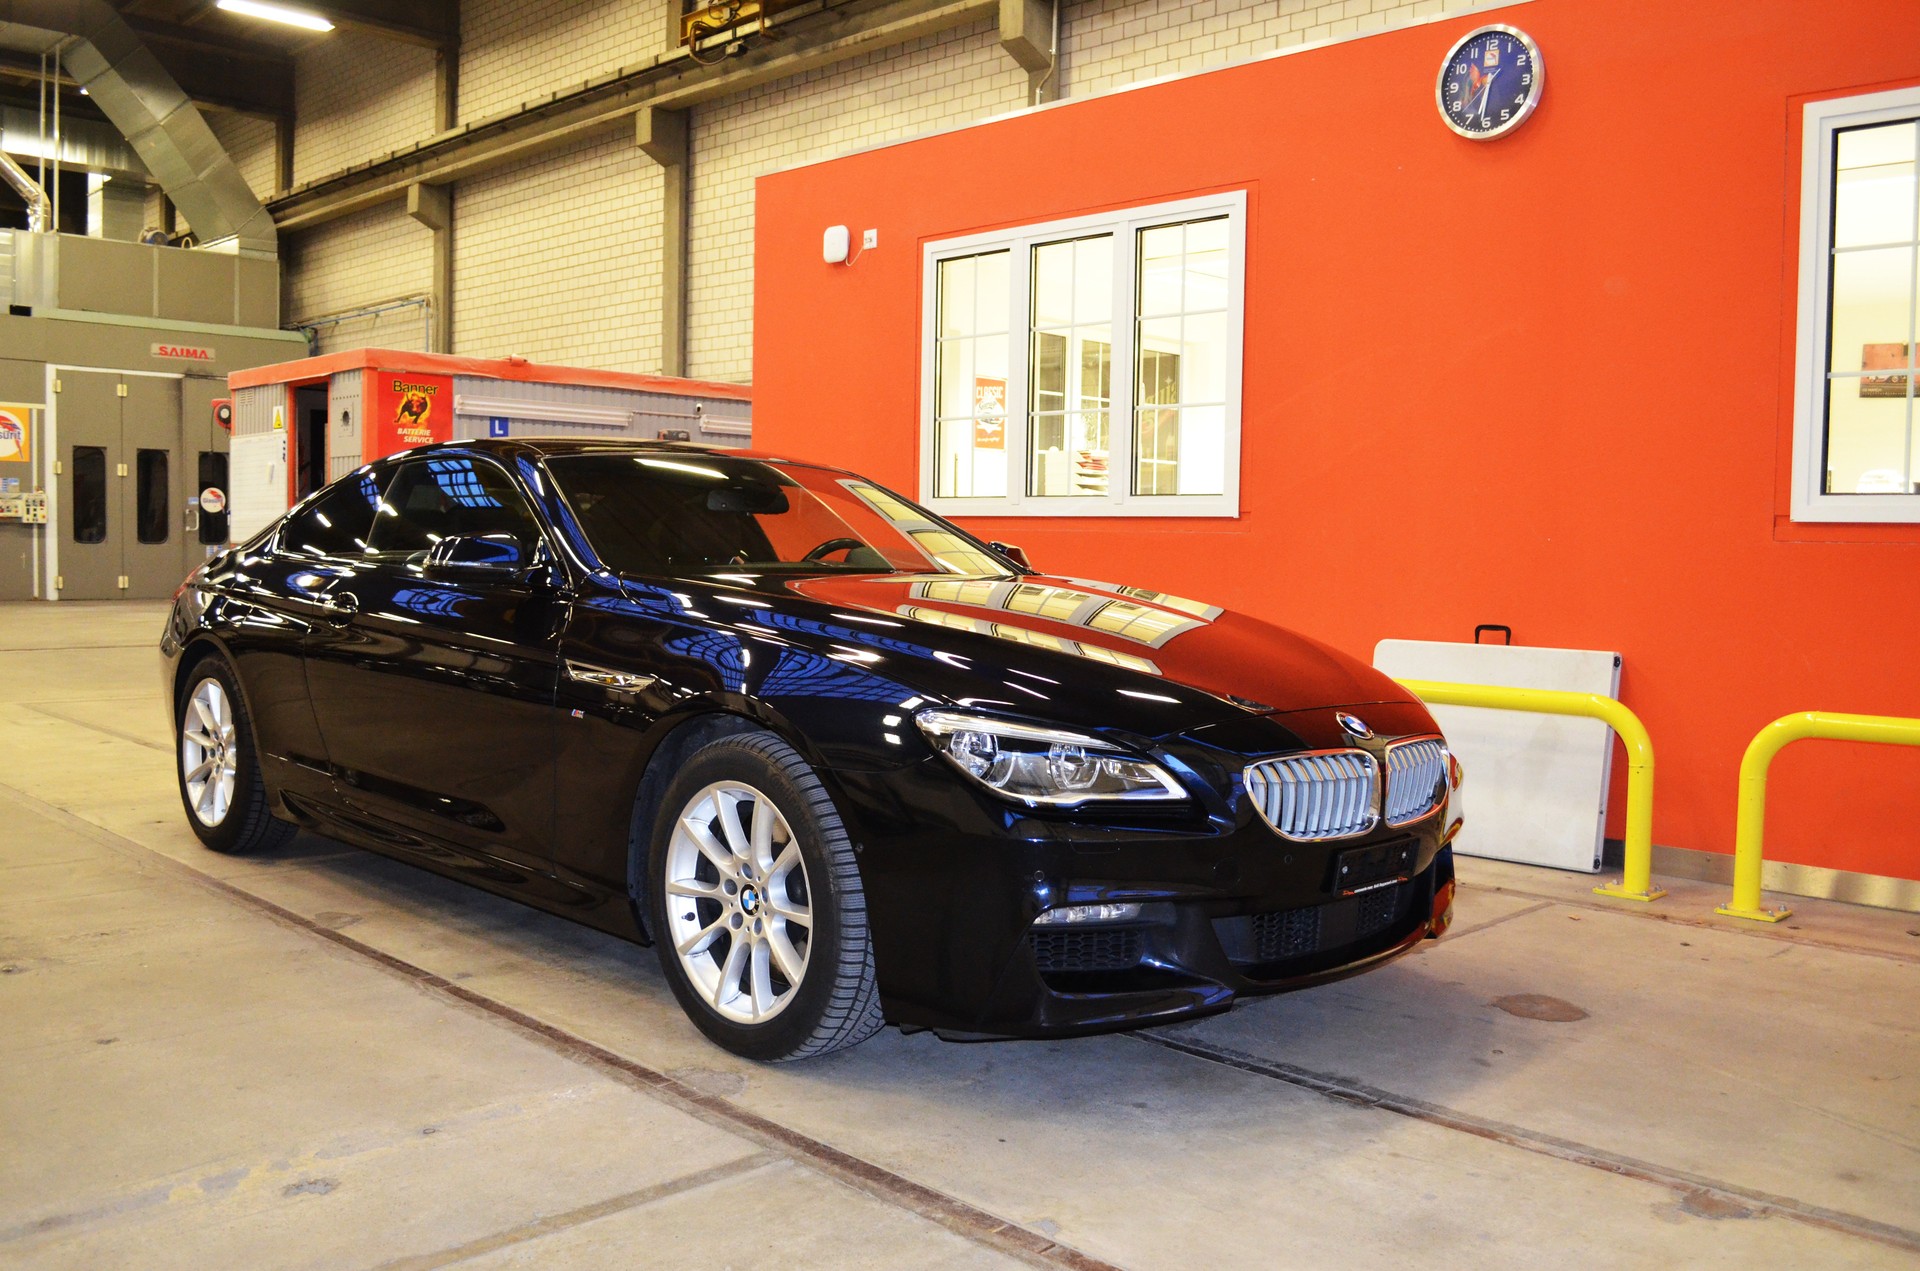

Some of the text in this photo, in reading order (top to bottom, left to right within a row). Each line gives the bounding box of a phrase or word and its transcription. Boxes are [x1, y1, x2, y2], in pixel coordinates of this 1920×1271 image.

[1486, 39, 1499, 50] 12
[1507, 42, 1512, 53] 1
[1470, 48, 1479, 59] 11
[1517, 55, 1527, 66] 2
[1456, 64, 1467, 75] 10
[1521, 74, 1530, 85] 3
[1450, 83, 1459, 93] 9
[1514, 94, 1524, 104] 4
[1453, 101, 1462, 112] 8
[1465, 114, 1474, 125] 7
[1500, 109, 1510, 121] 5
[1482, 117, 1491, 128] 6
[159, 346, 209, 360] SAIMA
[393, 380, 439, 395] Banner
[397, 427, 431, 436] BATTERIE
[494, 419, 504, 434] L
[403, 436, 434, 444] SERVICE
